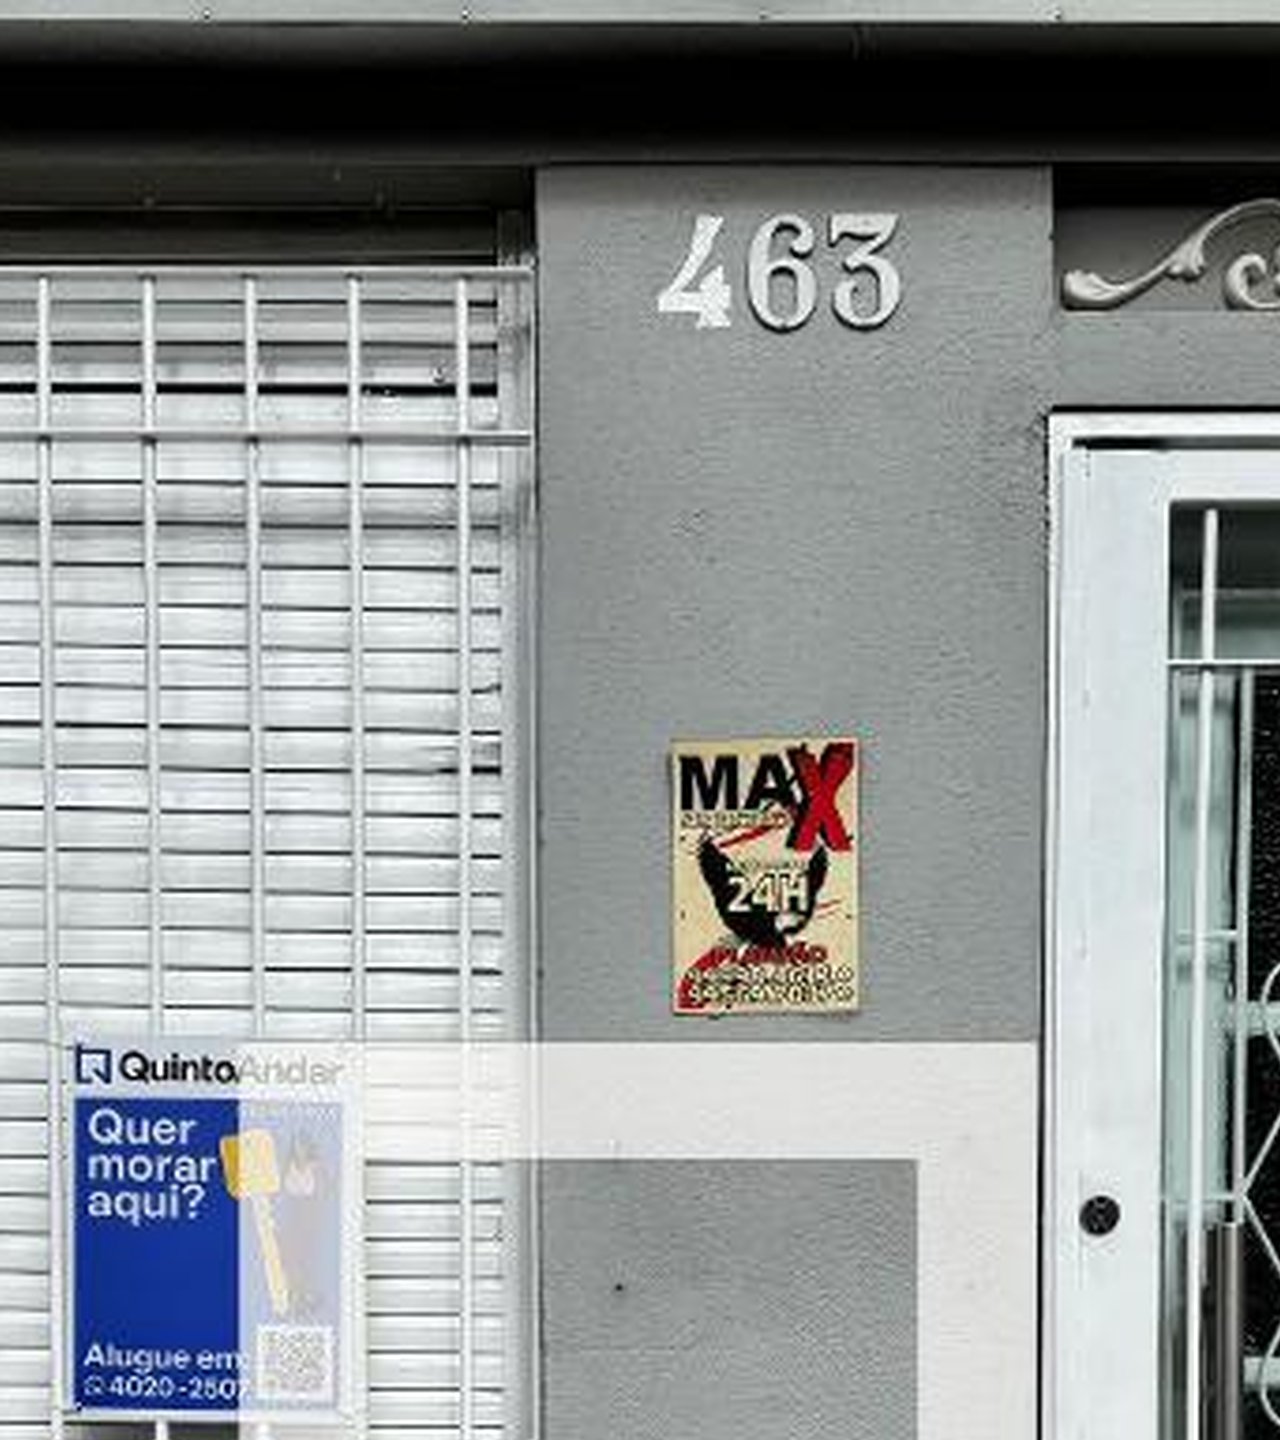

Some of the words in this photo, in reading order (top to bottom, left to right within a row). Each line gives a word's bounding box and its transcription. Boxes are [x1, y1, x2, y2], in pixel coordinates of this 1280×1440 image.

[657, 213, 901, 333] 463
[677, 742, 855, 852] MAX
[727, 872, 809, 913] 24H
[119, 1050, 344, 1084] QuintoAndar
[87, 1108, 198, 1147] Quer
[87, 1152, 218, 1182] morar
[87, 1184, 206, 1227] aqui?
[83, 1343, 190, 1376] Alugue
